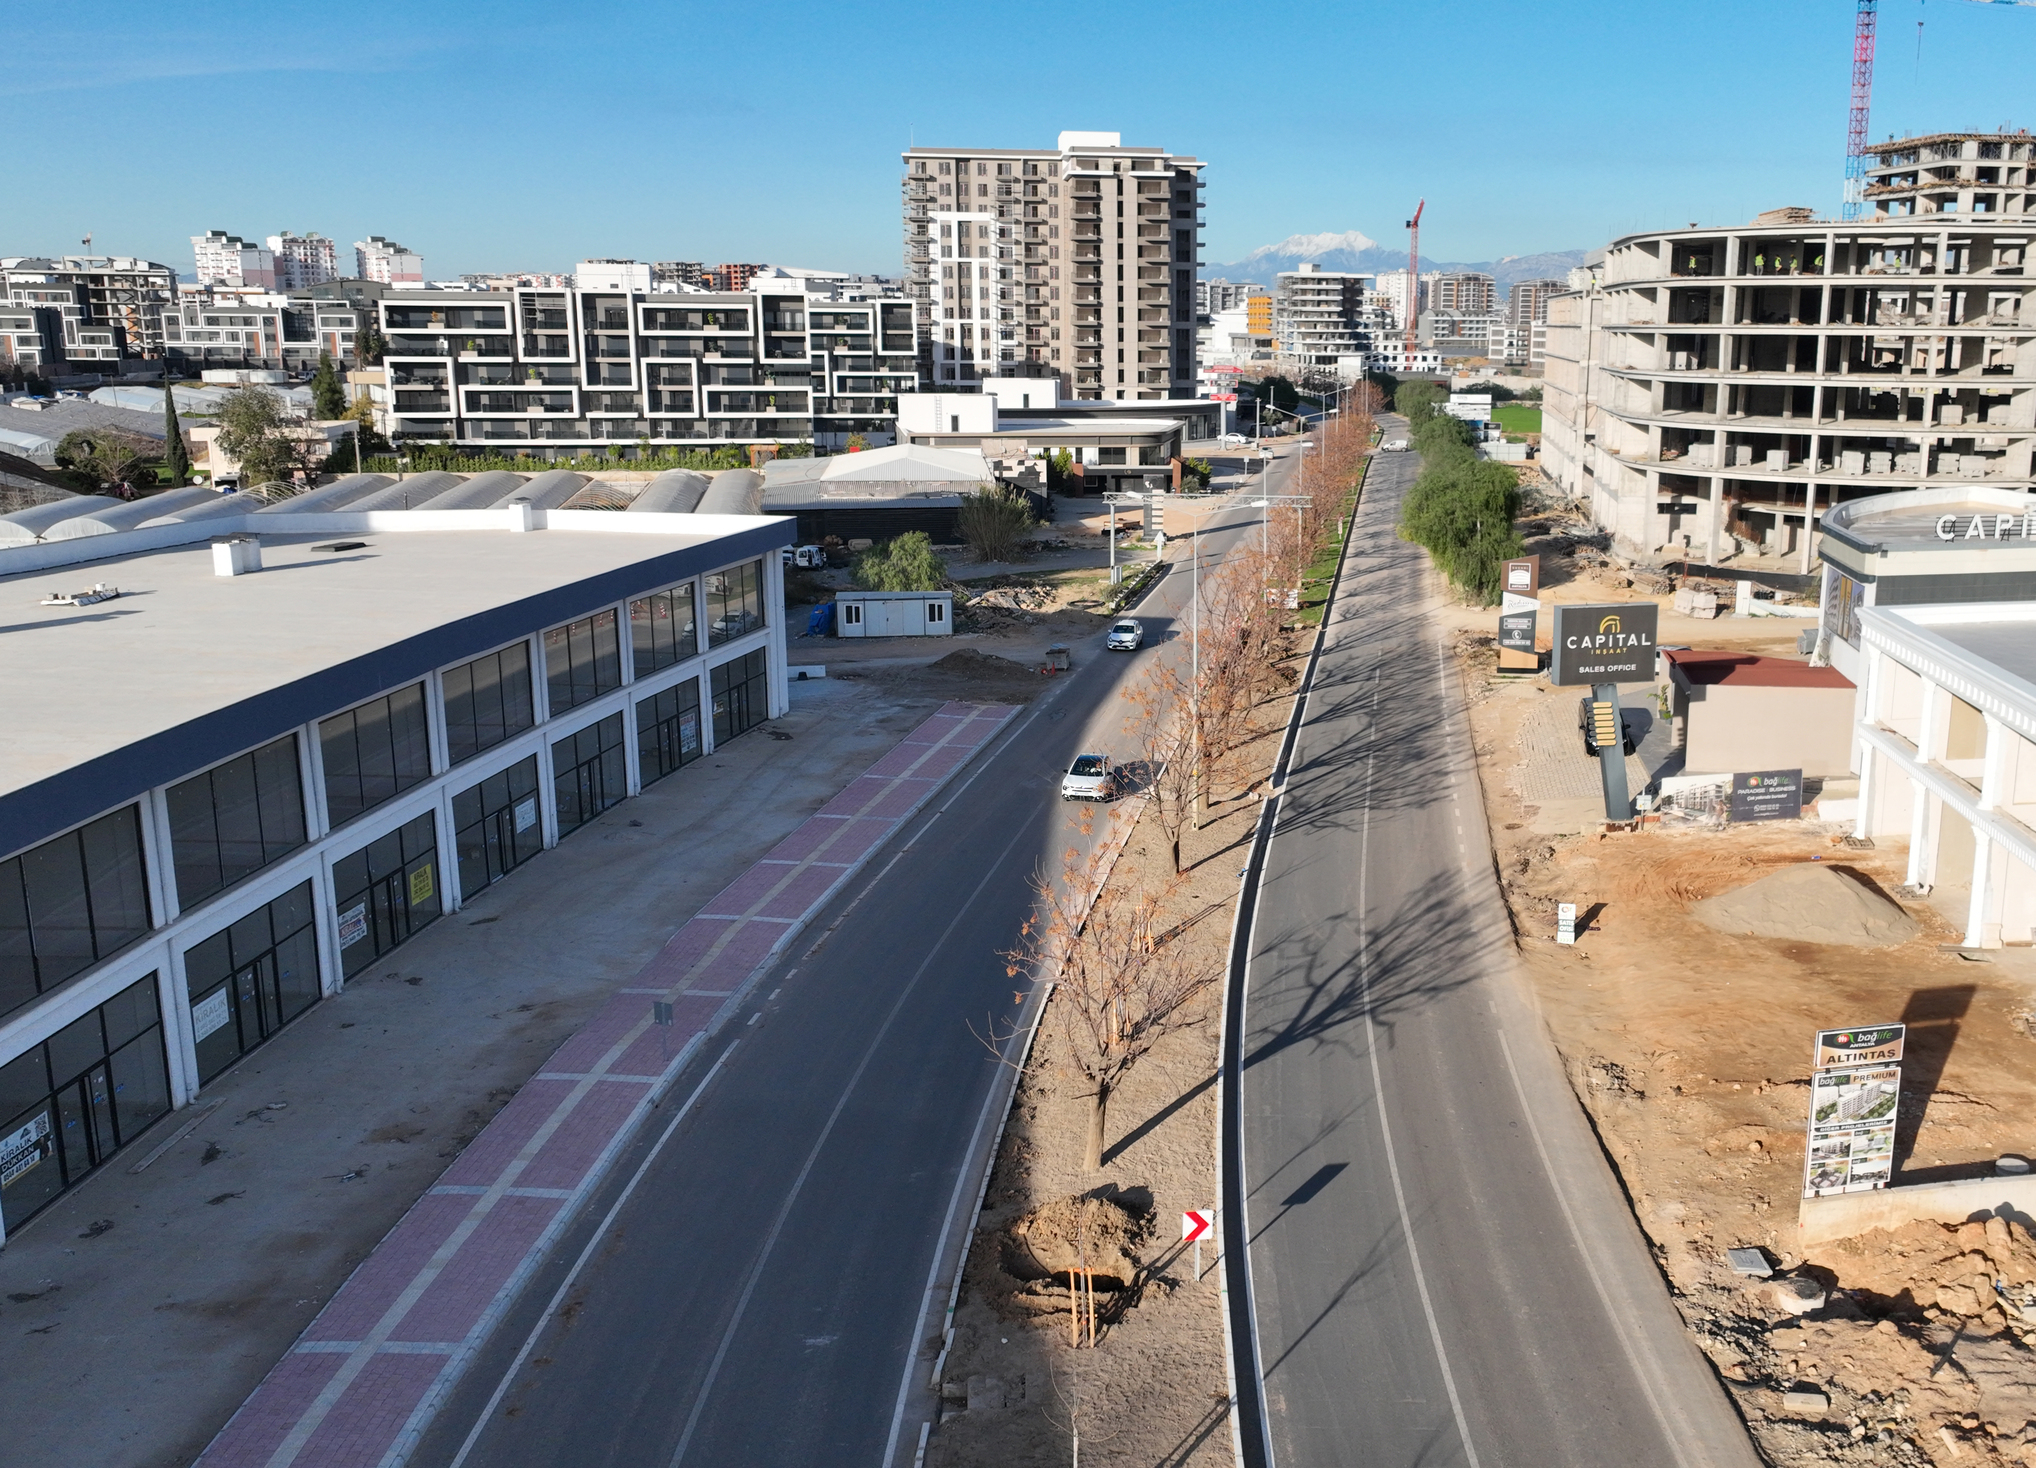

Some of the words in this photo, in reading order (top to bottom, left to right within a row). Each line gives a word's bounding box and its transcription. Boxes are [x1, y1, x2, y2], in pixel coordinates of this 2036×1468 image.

[1579, 665, 1605, 674] SALES
[1607, 664, 1637, 672] OFFICE
[1853, 1071, 1897, 1082] PREMIUM
[0, 1135, 33, 1163] KİRALIK
